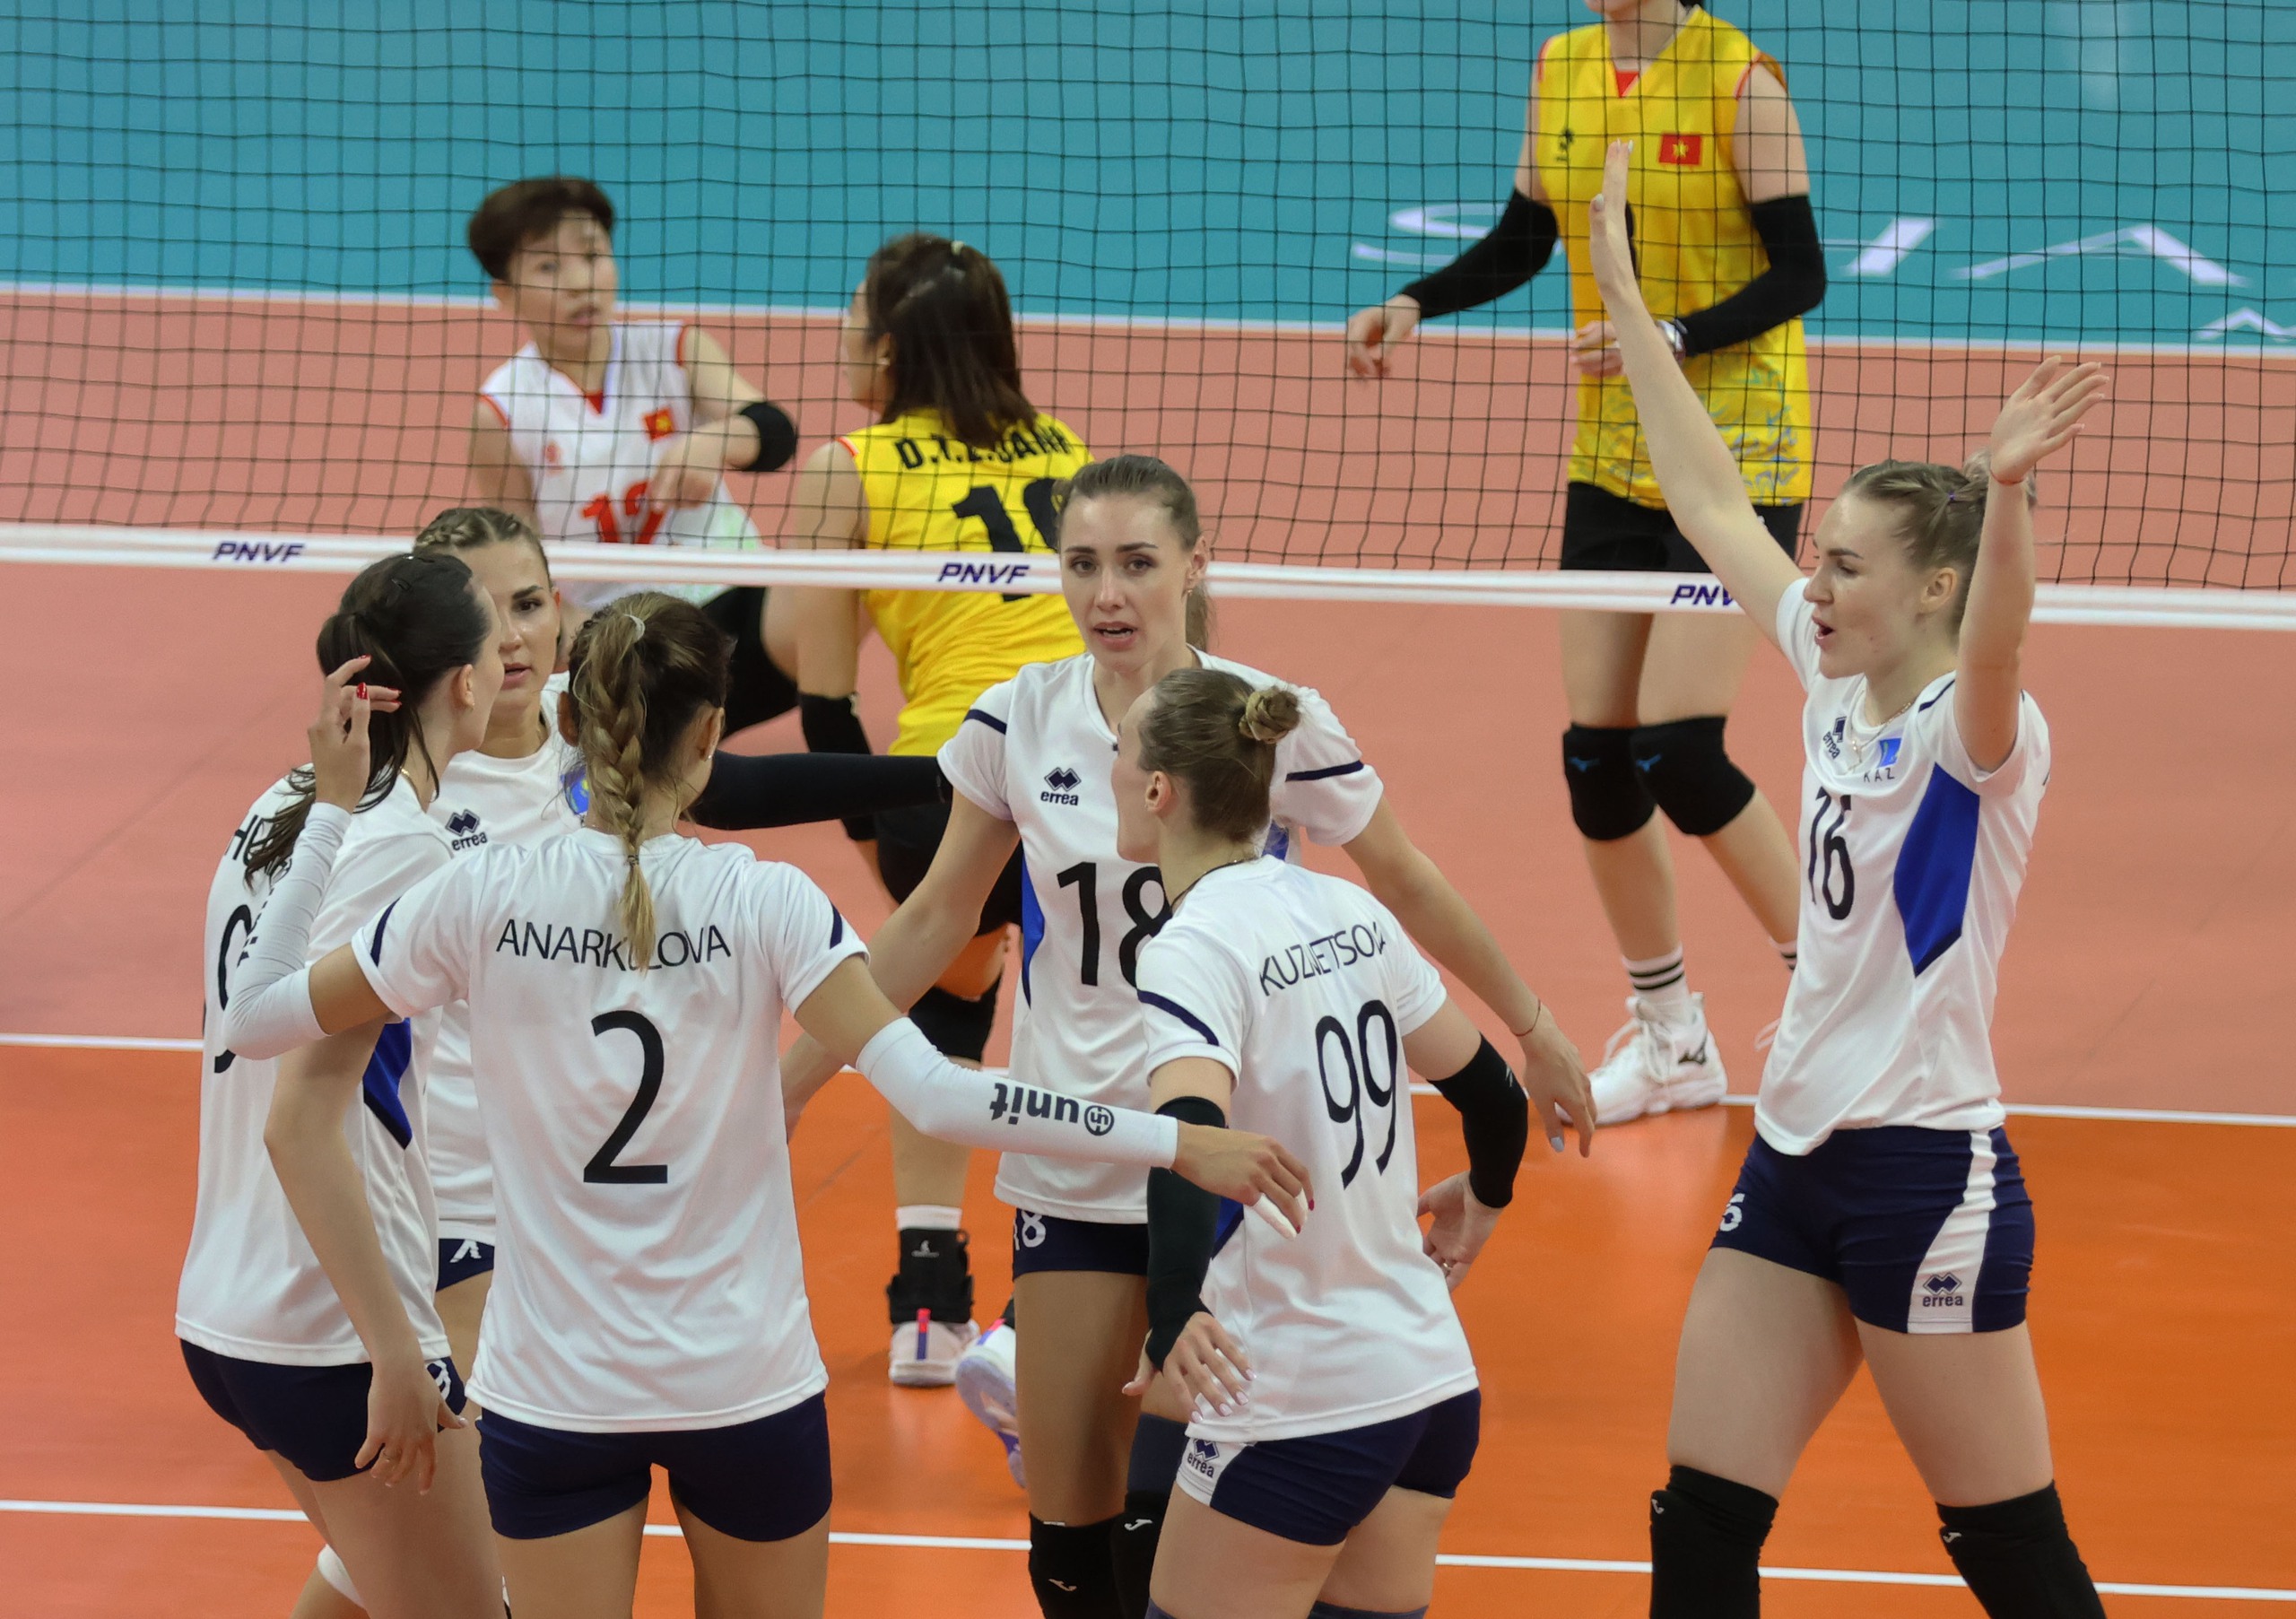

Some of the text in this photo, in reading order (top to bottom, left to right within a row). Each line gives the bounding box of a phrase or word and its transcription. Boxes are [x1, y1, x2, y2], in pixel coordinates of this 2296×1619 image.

[213, 541, 305, 562] PNVF
[936, 562, 1031, 584] PNVF
[1822, 731, 1841, 760] errea
[1040, 791, 1079, 806] errea
[451, 831, 488, 851] errea
[1057, 861, 1173, 991] 18
[583, 1010, 668, 1184] 2
[989, 1083, 1079, 1125] unit
[1315, 999, 1398, 1191] 99
[1922, 1295, 1963, 1307] errea
[1187, 1452, 1215, 1478] errea
